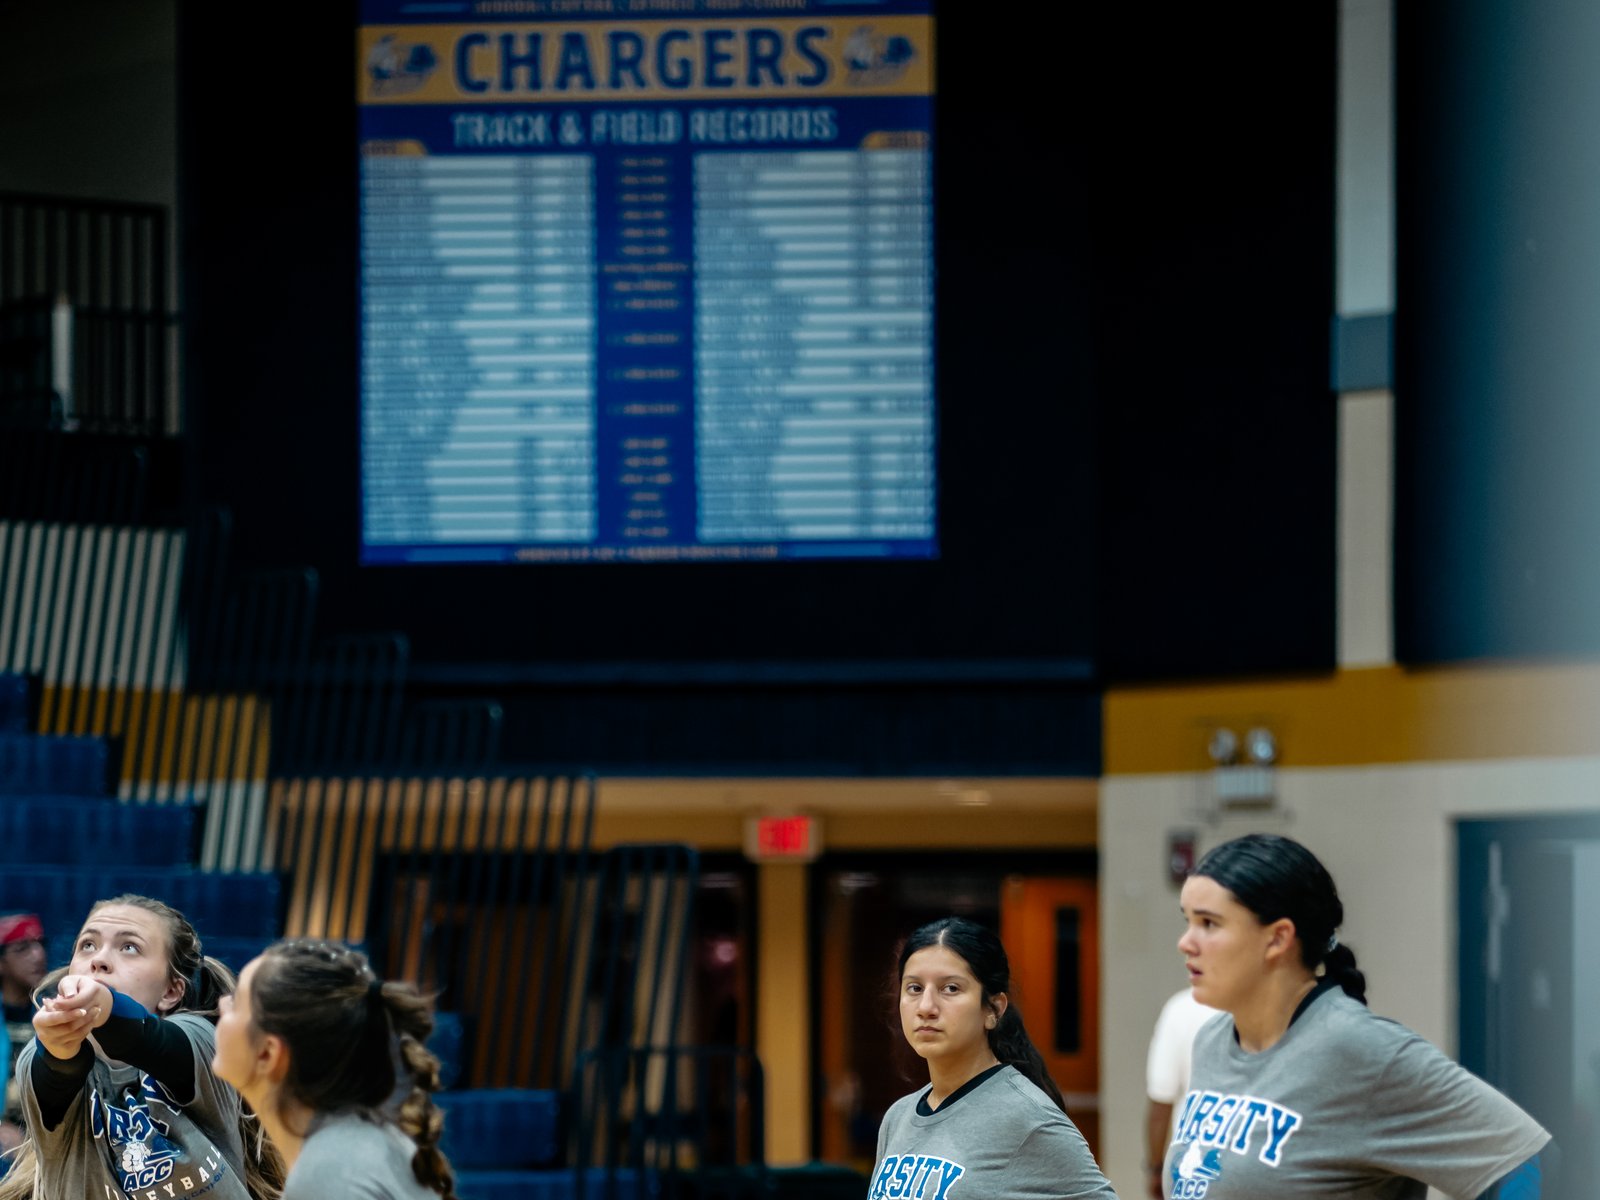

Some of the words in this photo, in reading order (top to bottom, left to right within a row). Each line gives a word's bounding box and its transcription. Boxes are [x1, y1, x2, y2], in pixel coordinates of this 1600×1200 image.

[453, 27, 834, 93] CHARGERS
[451, 111, 552, 147] TRACK
[558, 111, 583, 146] &
[591, 109, 683, 145] FIELD
[689, 107, 839, 142] RECORDS
[1170, 1090, 1302, 1168] RSITY
[124, 1158, 174, 1192] ACC
[1172, 1179, 1209, 1199] ACC
